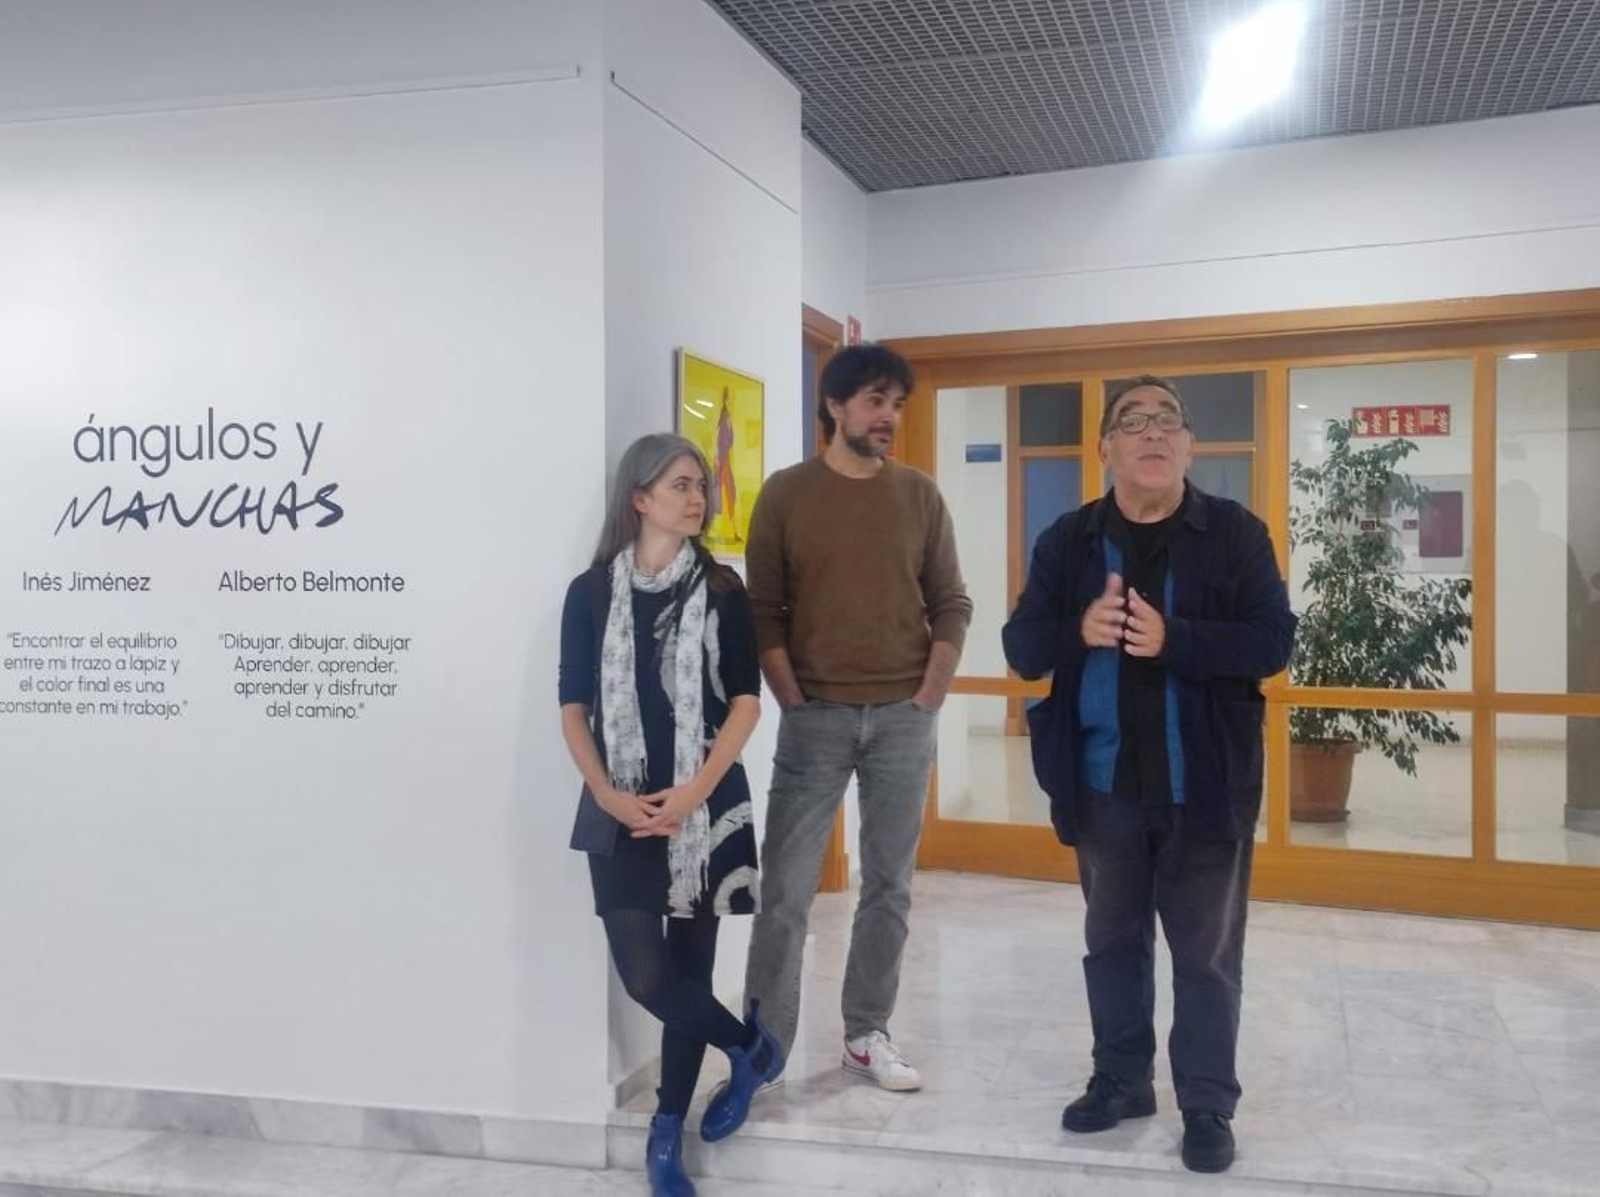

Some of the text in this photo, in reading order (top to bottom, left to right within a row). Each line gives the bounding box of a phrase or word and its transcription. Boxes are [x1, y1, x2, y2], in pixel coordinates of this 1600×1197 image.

[73, 406, 324, 478] ángulos y
[54, 479, 345, 537] MANCHAS
[22, 570, 152, 593] Inés Jiménez
[218, 570, 405, 593] Alberto Belmonte
[89, 631, 104, 649] el
[106, 632, 179, 655] equilibrio
[352, 632, 412, 656] dibujar
[3, 653, 181, 677] entre mi trazo a lápiz y
[18, 674, 166, 694] el color final es una
[233, 676, 399, 701] aprender y disfrutar
[75, 702, 96, 715] en
[98, 699, 119, 715] mi
[265, 699, 292, 719] del
